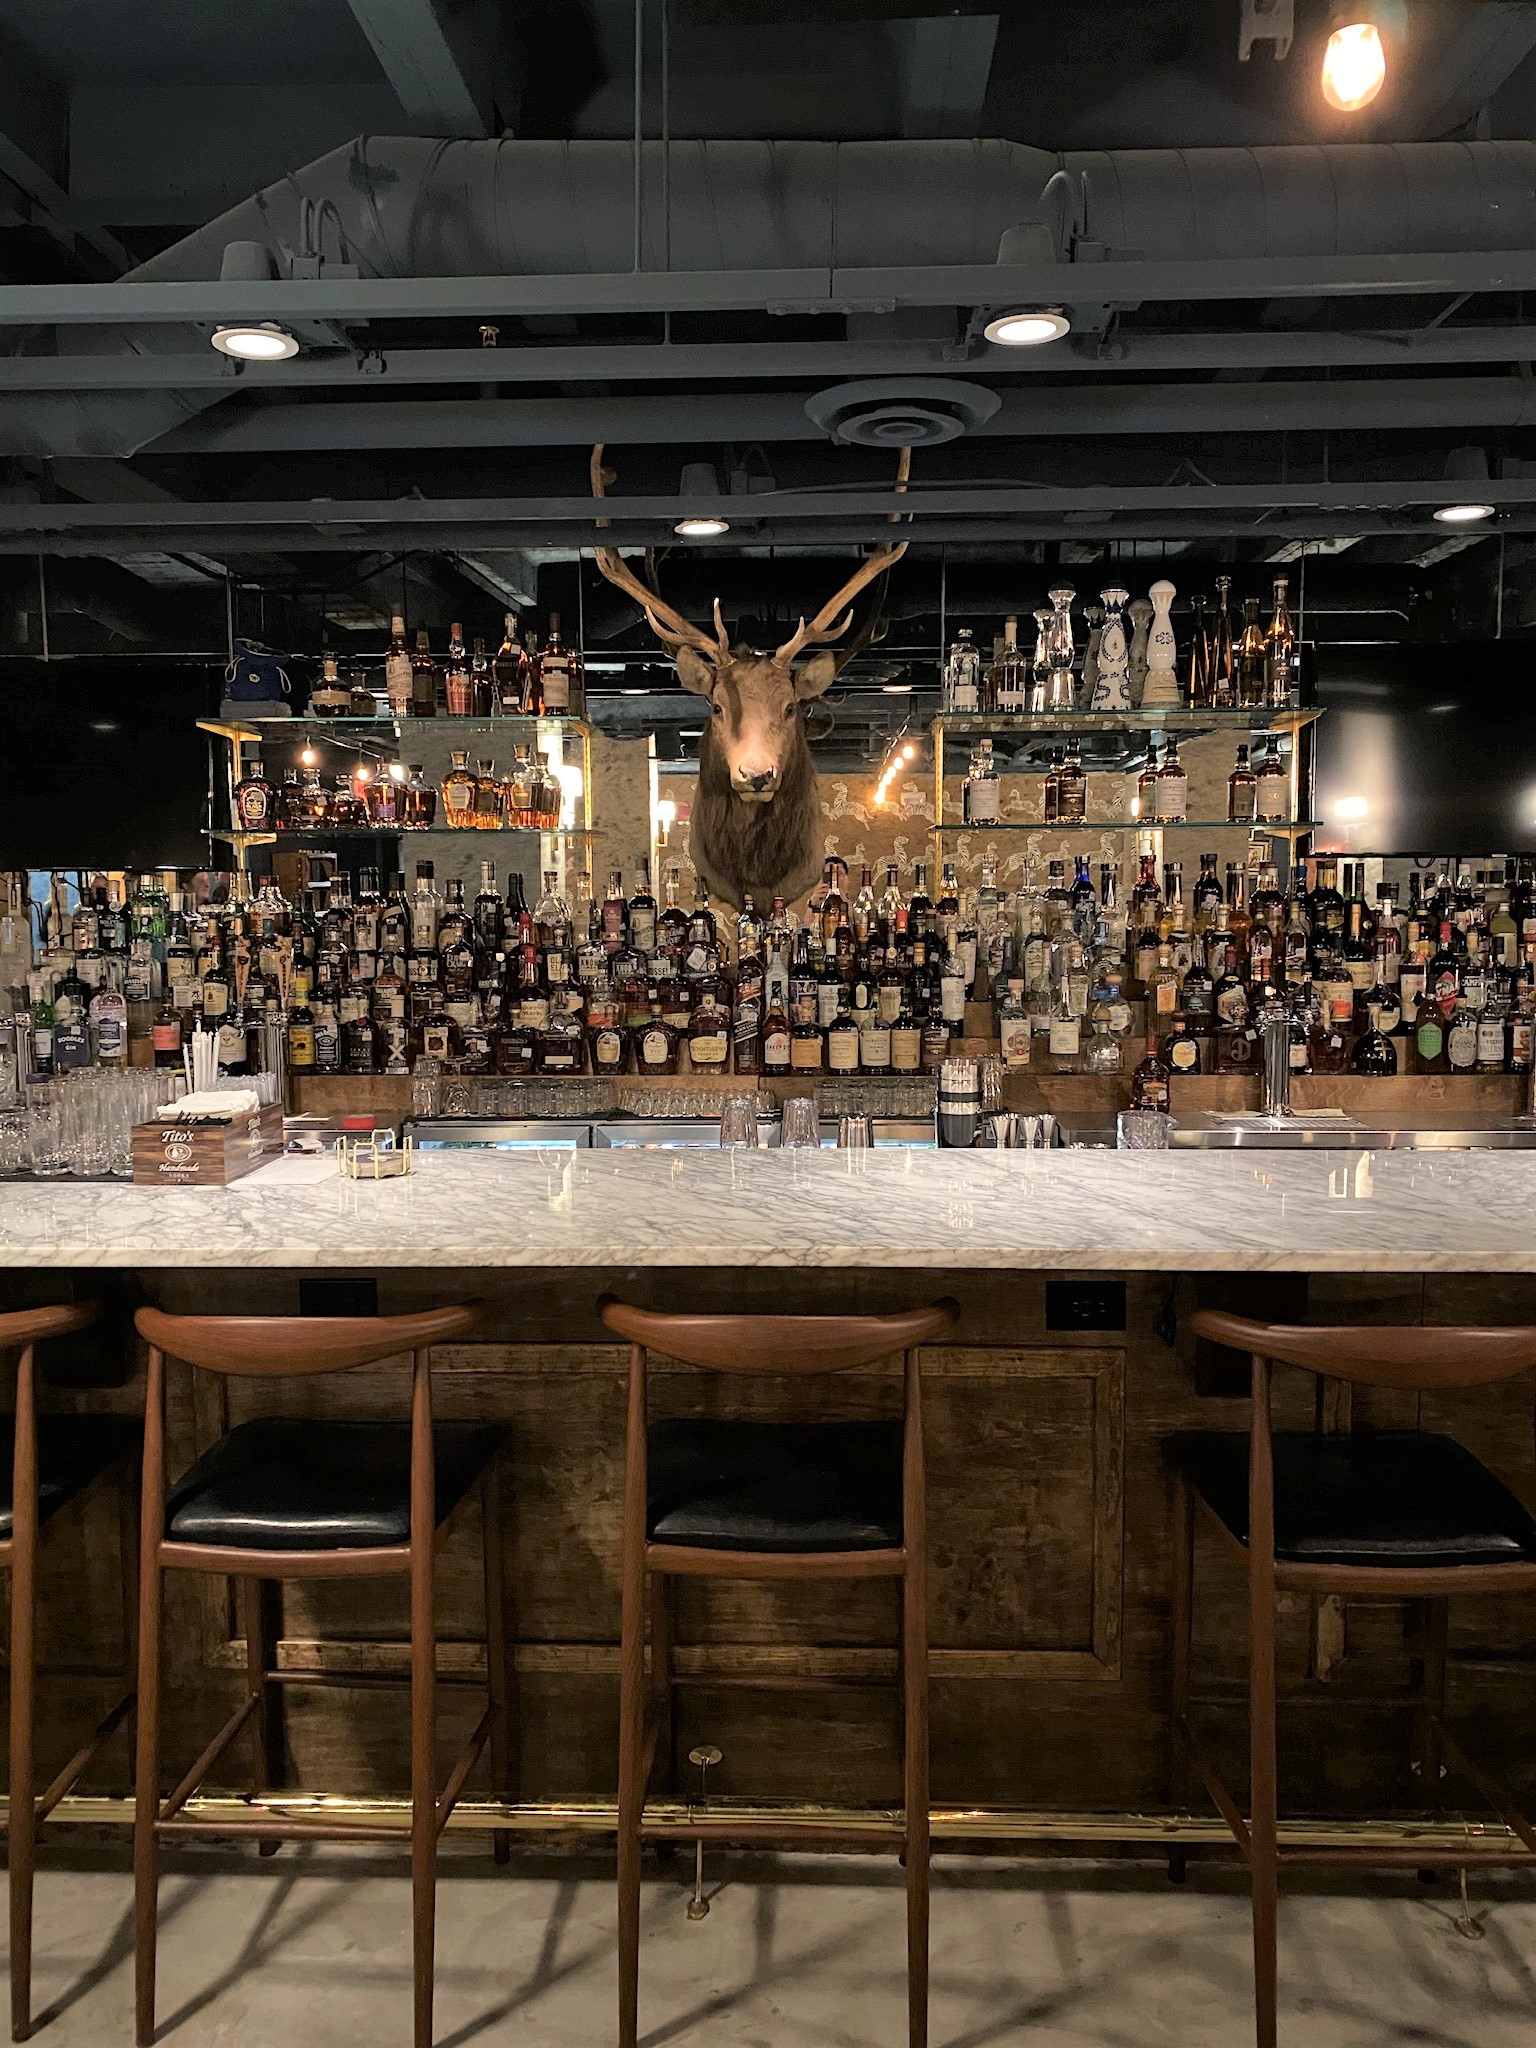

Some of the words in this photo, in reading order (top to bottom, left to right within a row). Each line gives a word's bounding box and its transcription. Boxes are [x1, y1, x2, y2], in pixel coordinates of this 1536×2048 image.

[57, 1036, 85, 1044] BOODLES
[161, 1129, 195, 1143] Tito's
[158, 1162, 200, 1172] Handmade
